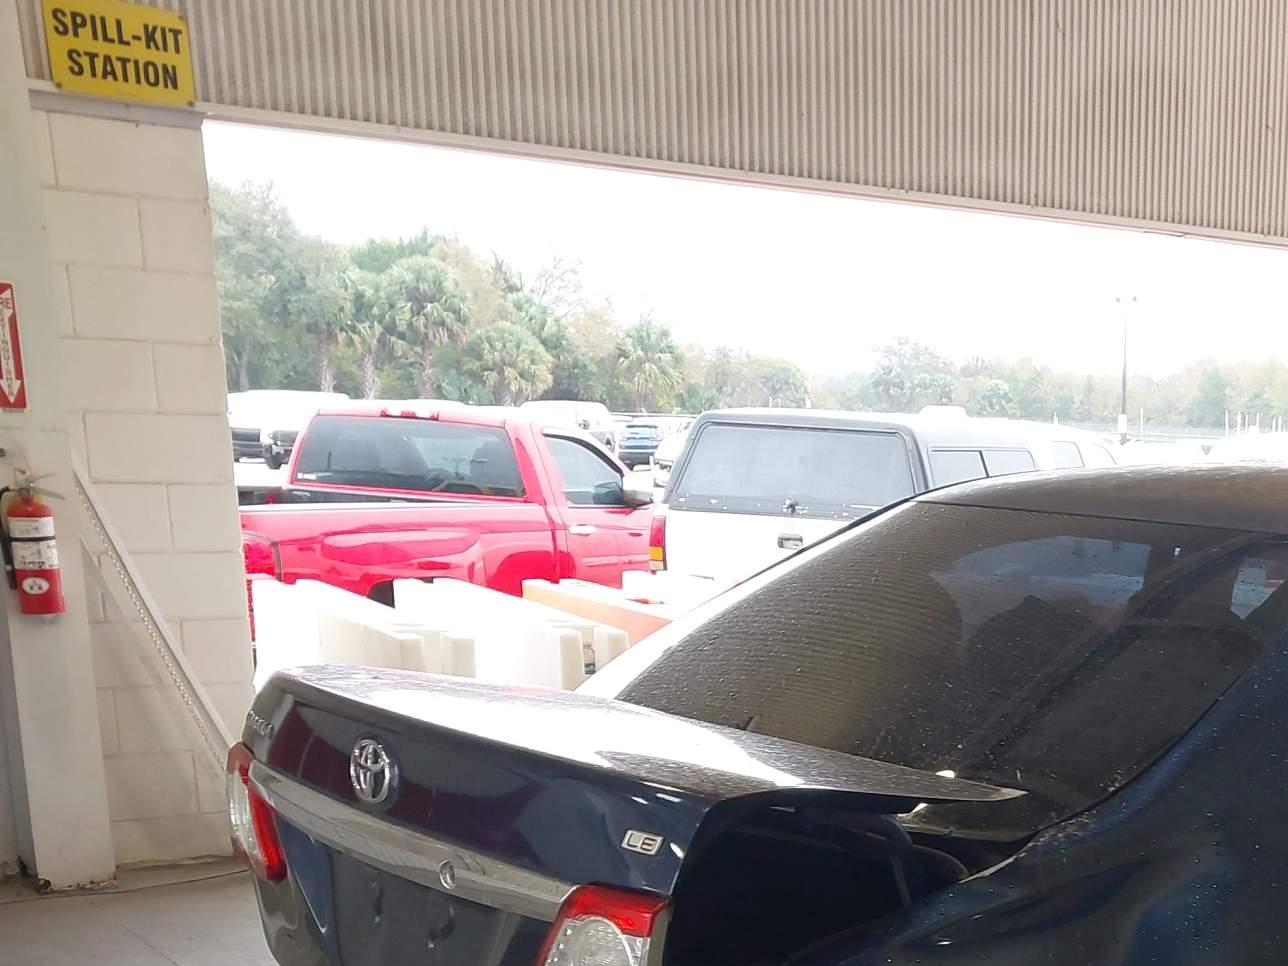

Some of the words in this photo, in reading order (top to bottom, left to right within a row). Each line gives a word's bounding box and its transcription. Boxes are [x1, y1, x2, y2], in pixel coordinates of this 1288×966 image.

[51, 8, 183, 55] SPILL-KIT
[66, 48, 179, 90] STATION
[625, 831, 659, 853] LE
